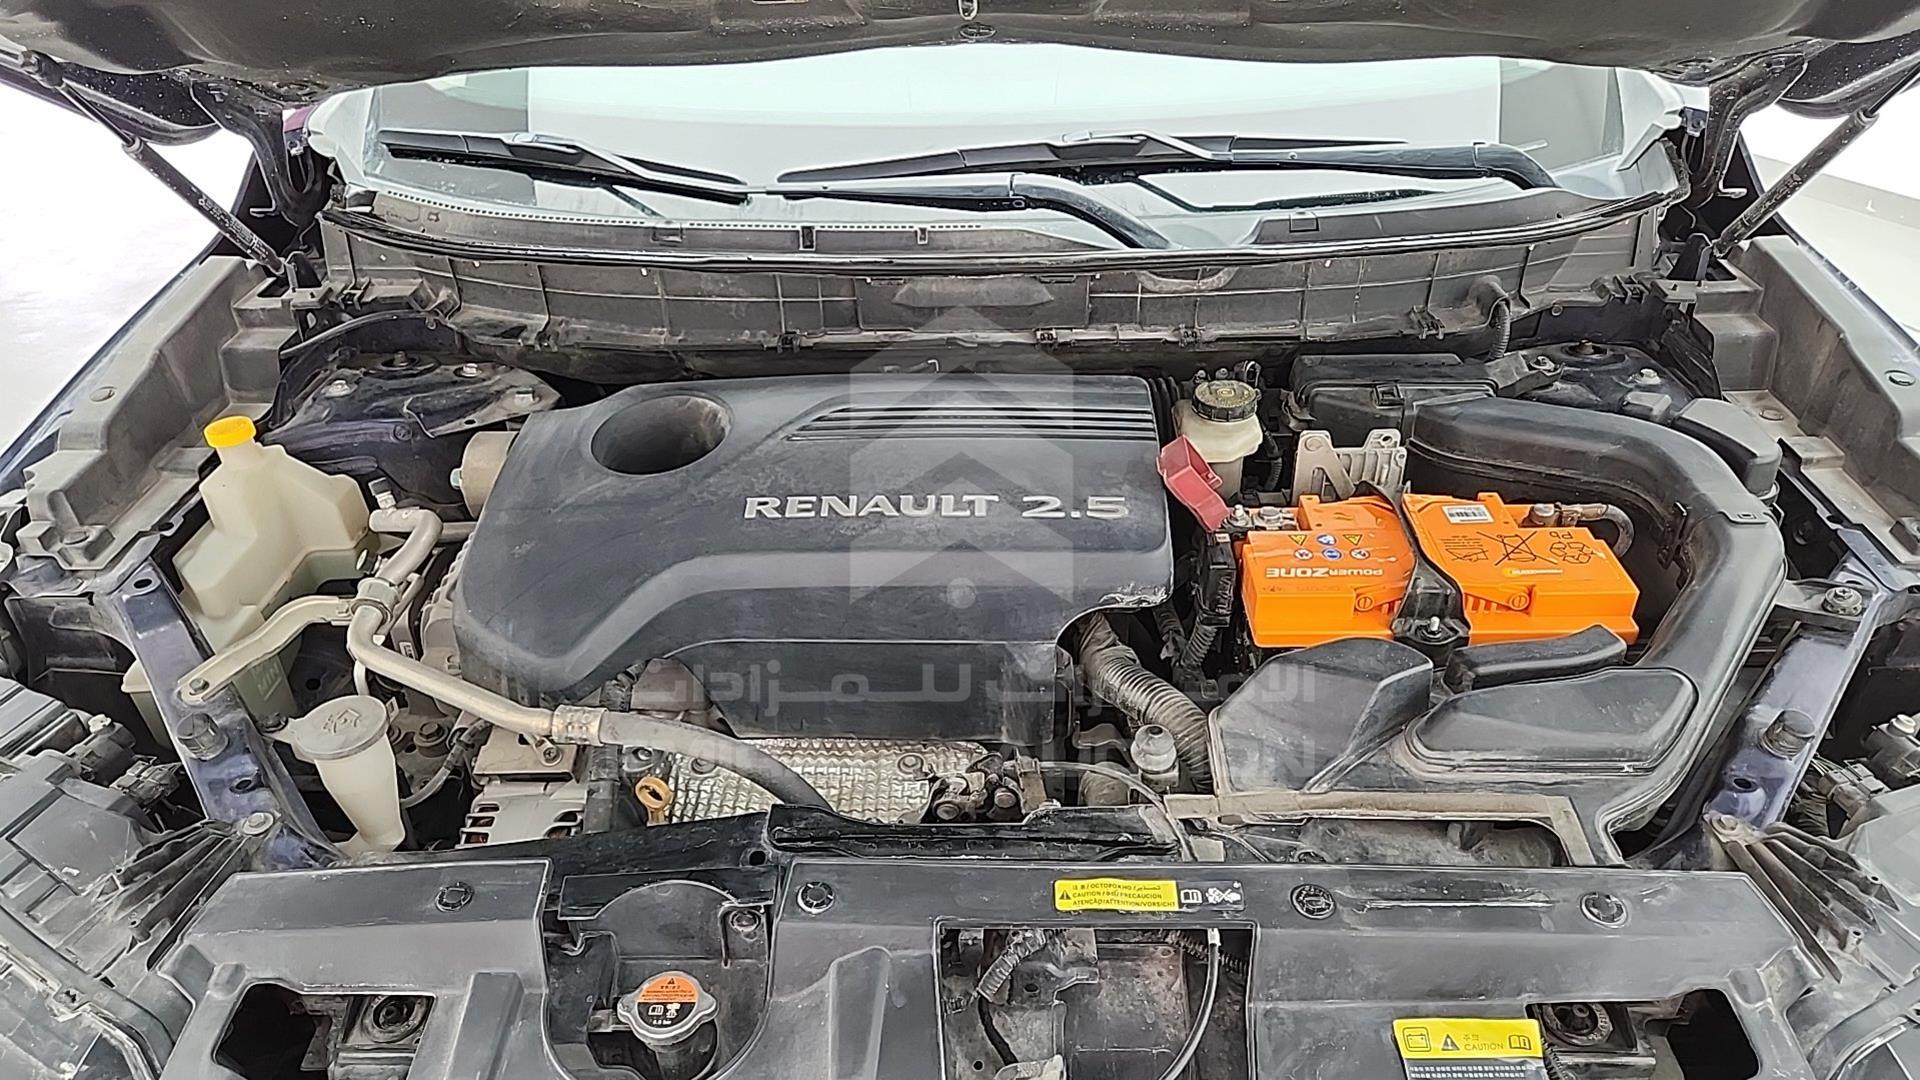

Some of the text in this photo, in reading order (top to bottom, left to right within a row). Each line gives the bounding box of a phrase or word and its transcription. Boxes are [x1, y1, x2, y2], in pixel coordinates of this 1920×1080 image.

[743, 494, 1130, 519] RENAULT 2.5
[1548, 530, 1574, 540] Pb
[1463, 1042, 1504, 1051] CAUTION
